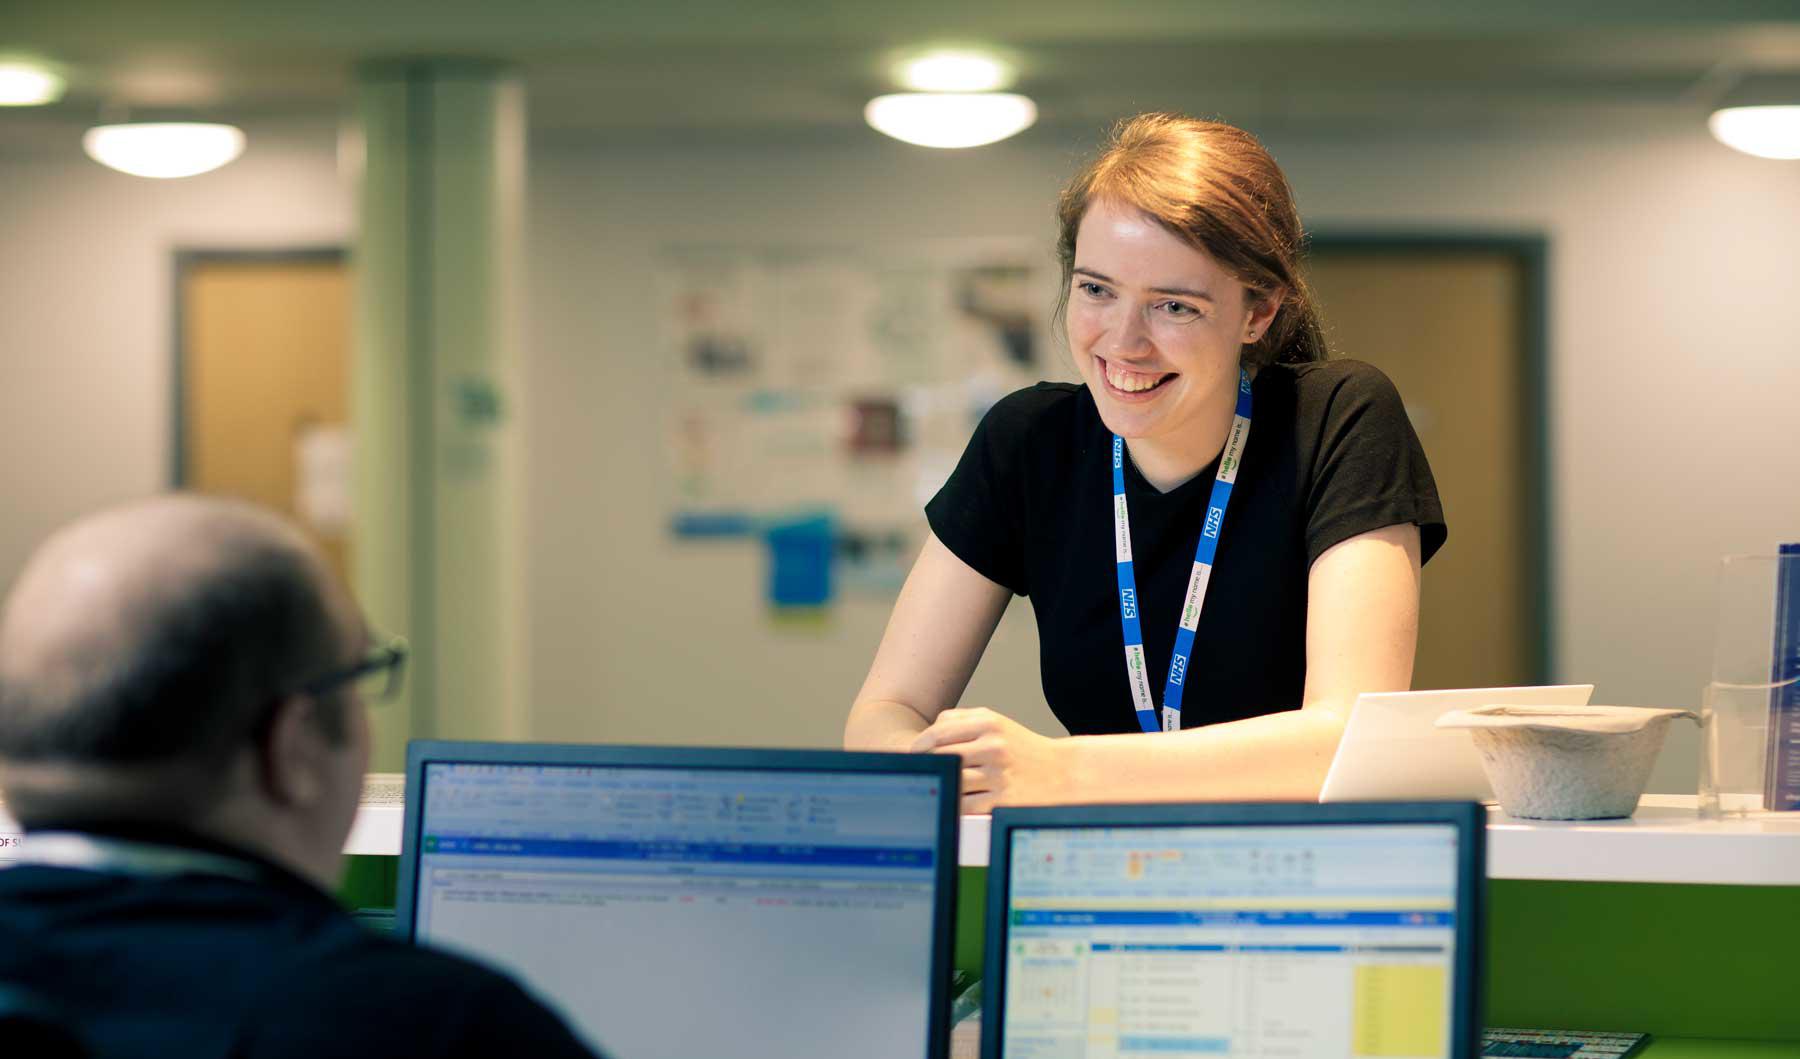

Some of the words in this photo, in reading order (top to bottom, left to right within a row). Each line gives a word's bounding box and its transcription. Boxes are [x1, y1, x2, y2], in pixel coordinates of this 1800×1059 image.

[1232, 430, 1241, 447] name
[1114, 438, 1122, 469] NHS
[1205, 508, 1222, 538] NHS
[1192, 576, 1200, 593] name
[1122, 589, 1136, 618] NHS
[1170, 655, 1186, 685] NHS
